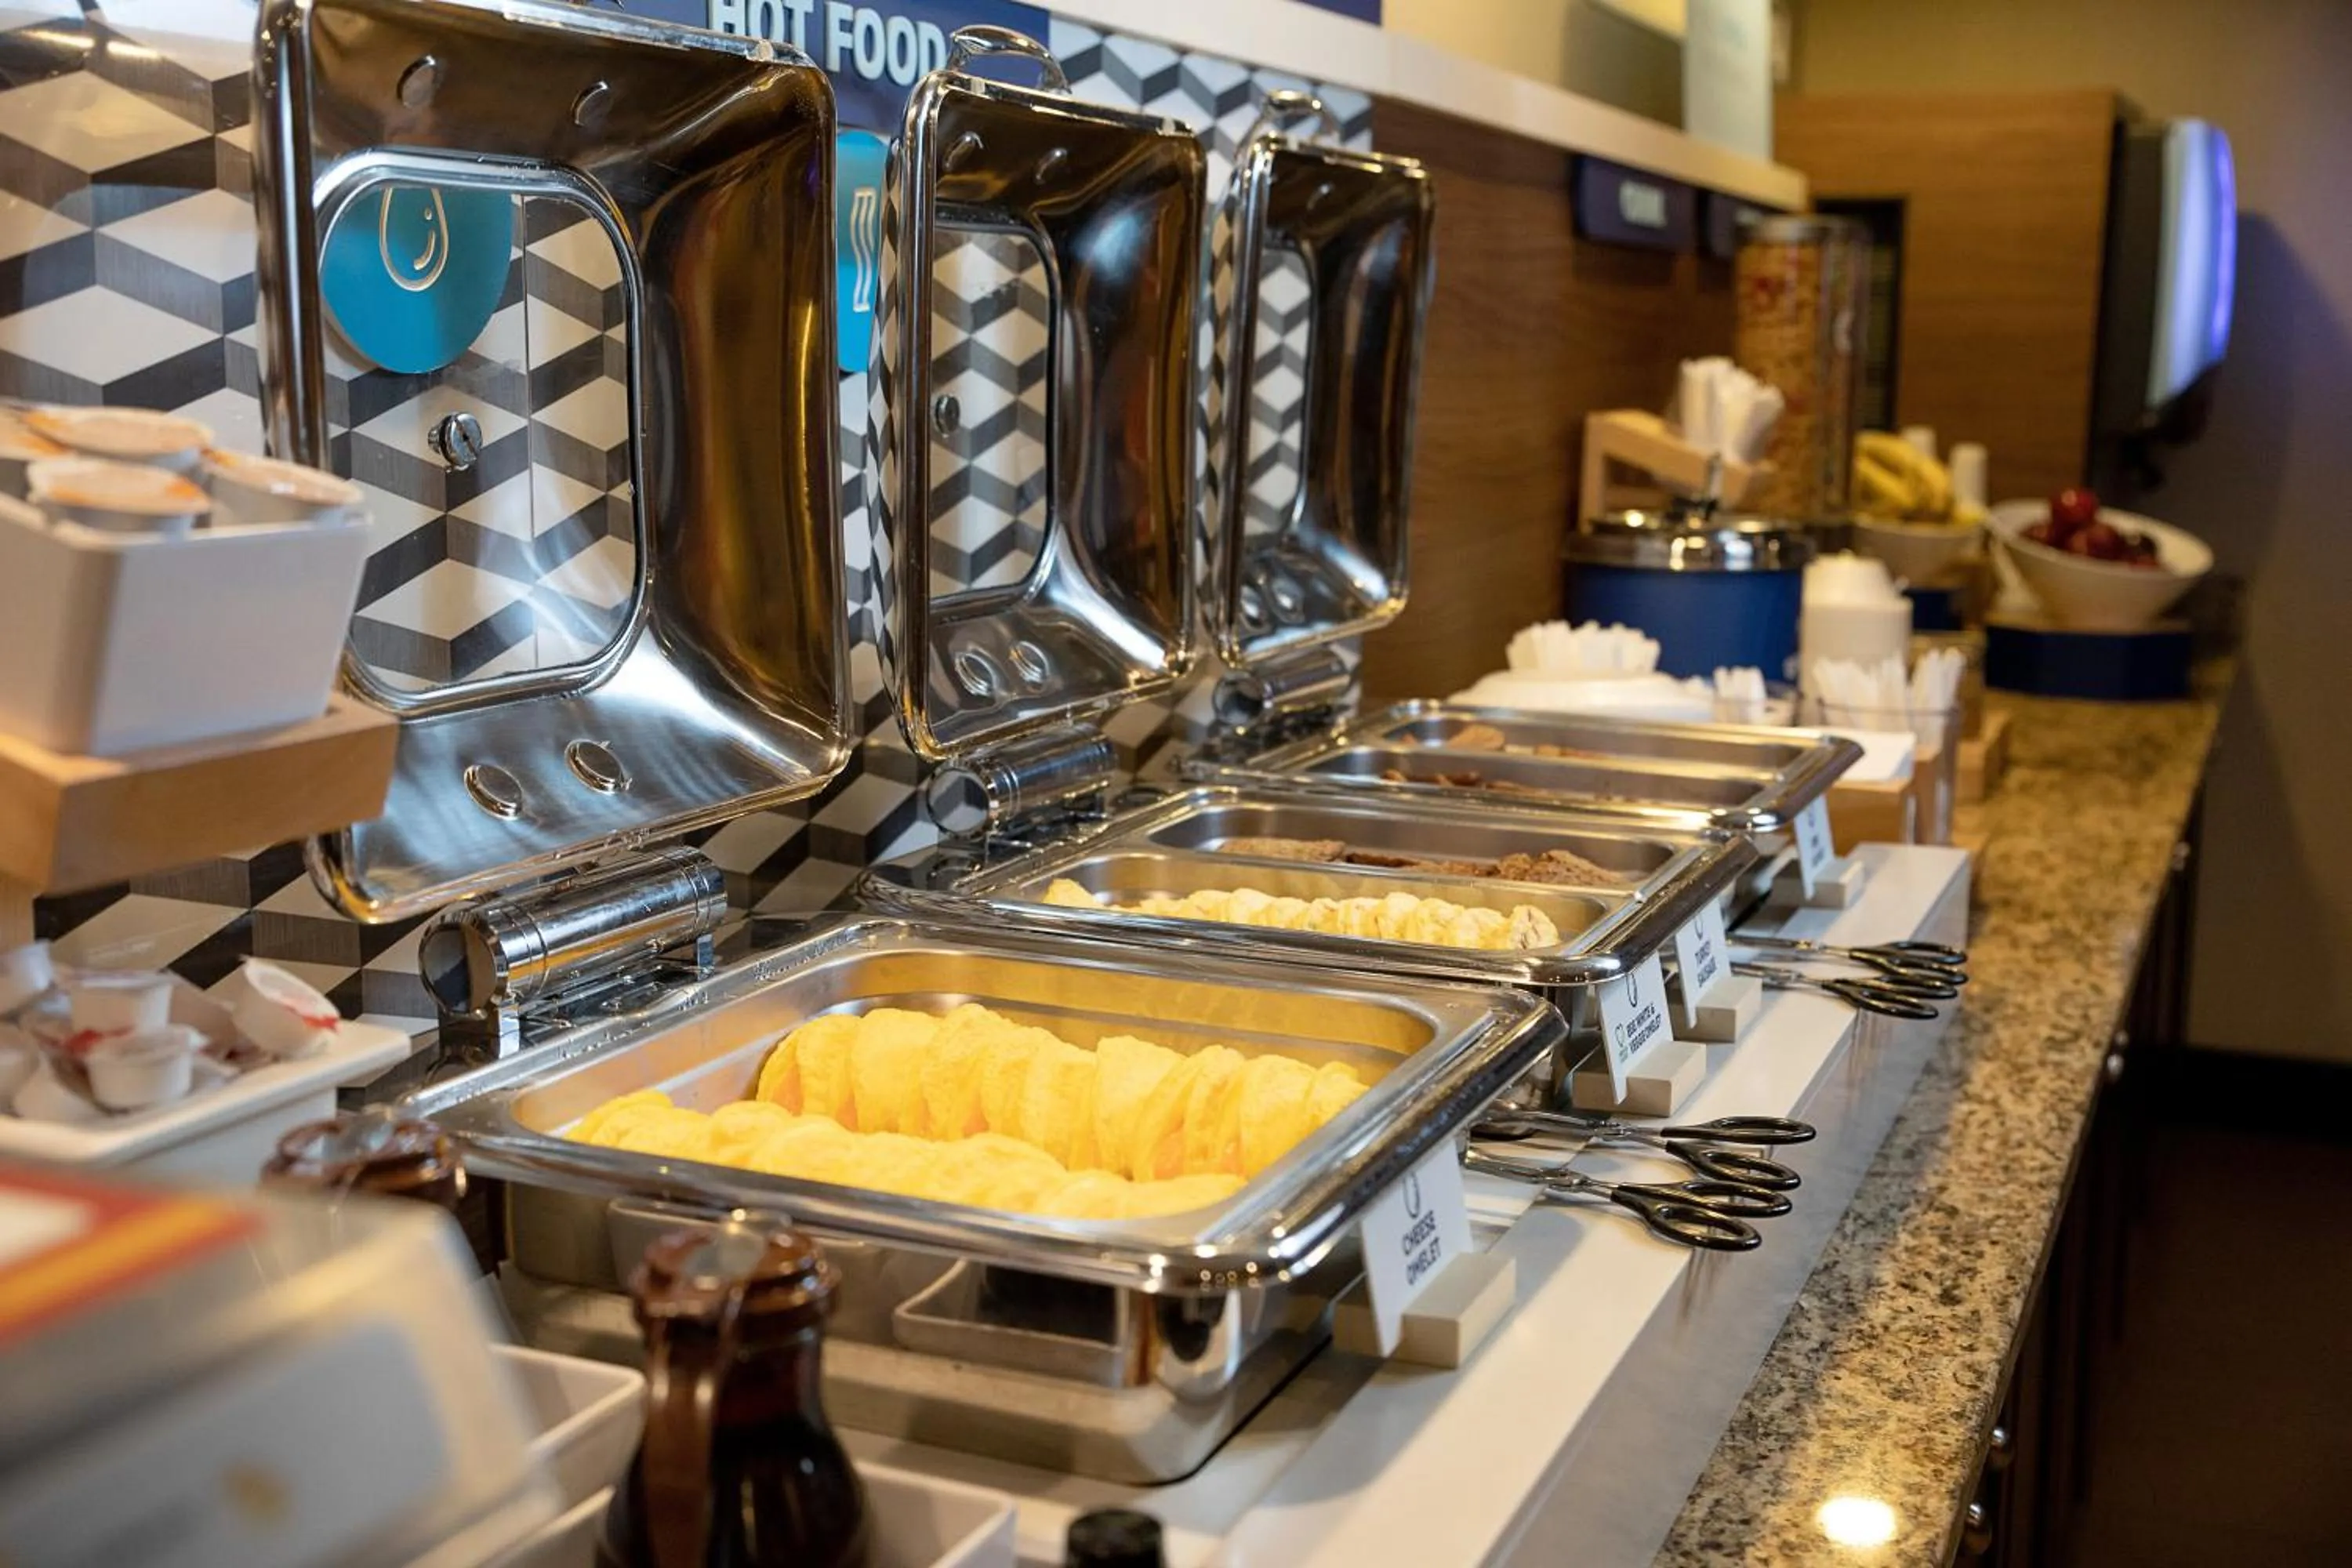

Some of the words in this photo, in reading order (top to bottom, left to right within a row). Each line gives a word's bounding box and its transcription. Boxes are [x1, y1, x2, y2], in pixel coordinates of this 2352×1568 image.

[825, 1, 947, 85] FOOD
[1402, 1210, 1436, 1256] CHEESE
[1406, 1236, 1442, 1286] OMELET
